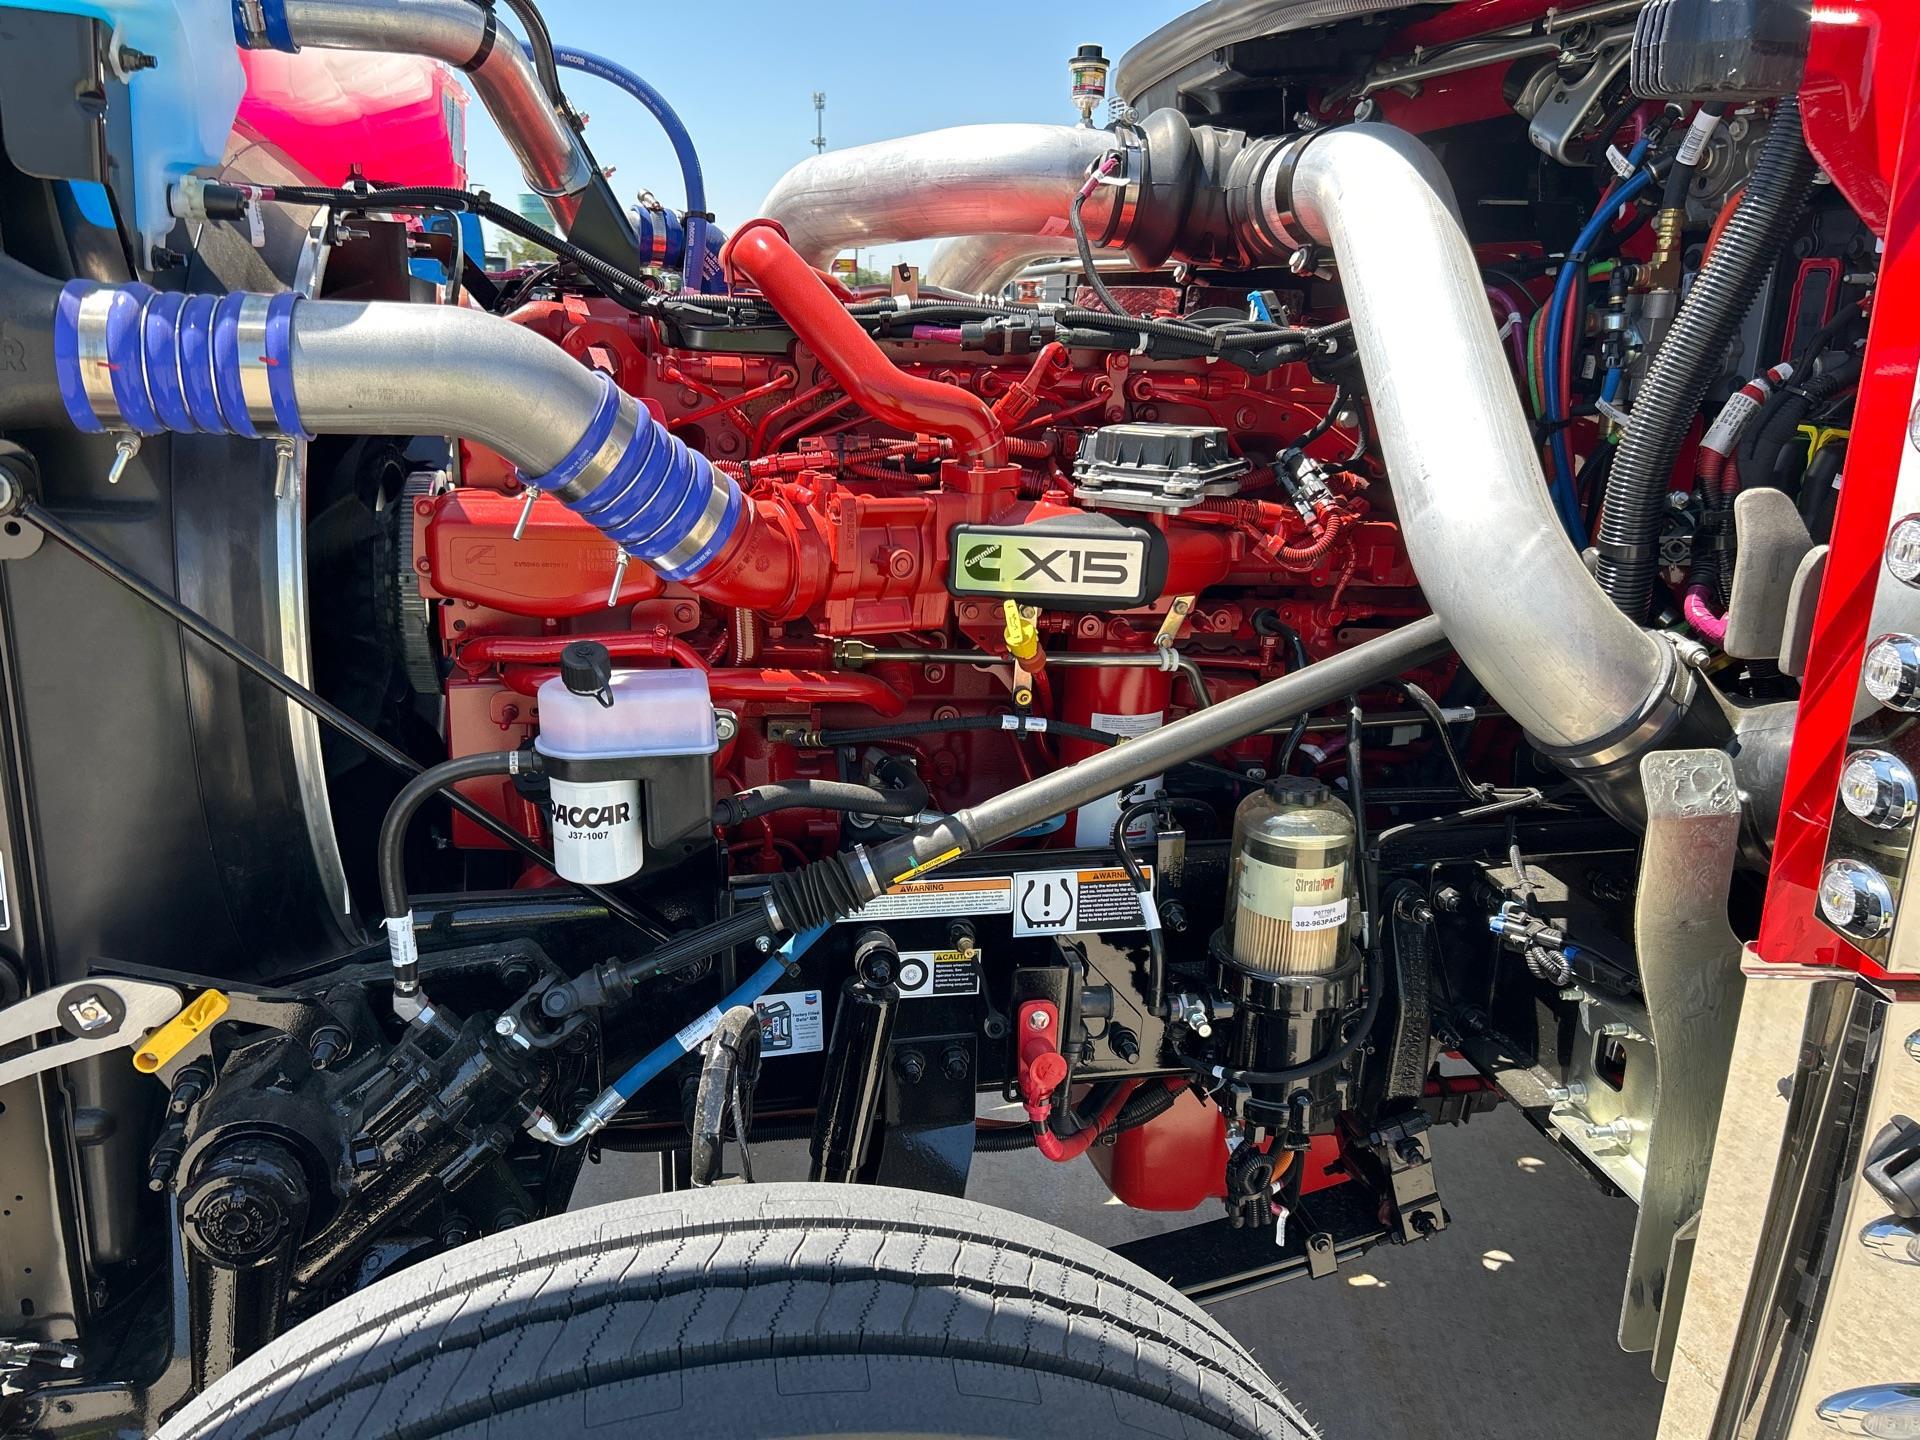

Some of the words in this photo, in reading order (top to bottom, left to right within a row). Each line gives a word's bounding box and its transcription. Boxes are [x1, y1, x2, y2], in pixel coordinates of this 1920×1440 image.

[965, 544, 1000, 568] Cummins
[1014, 547, 1129, 585] X15
[568, 831, 609, 840] J37-1007
[905, 884, 944, 893] WARNING
